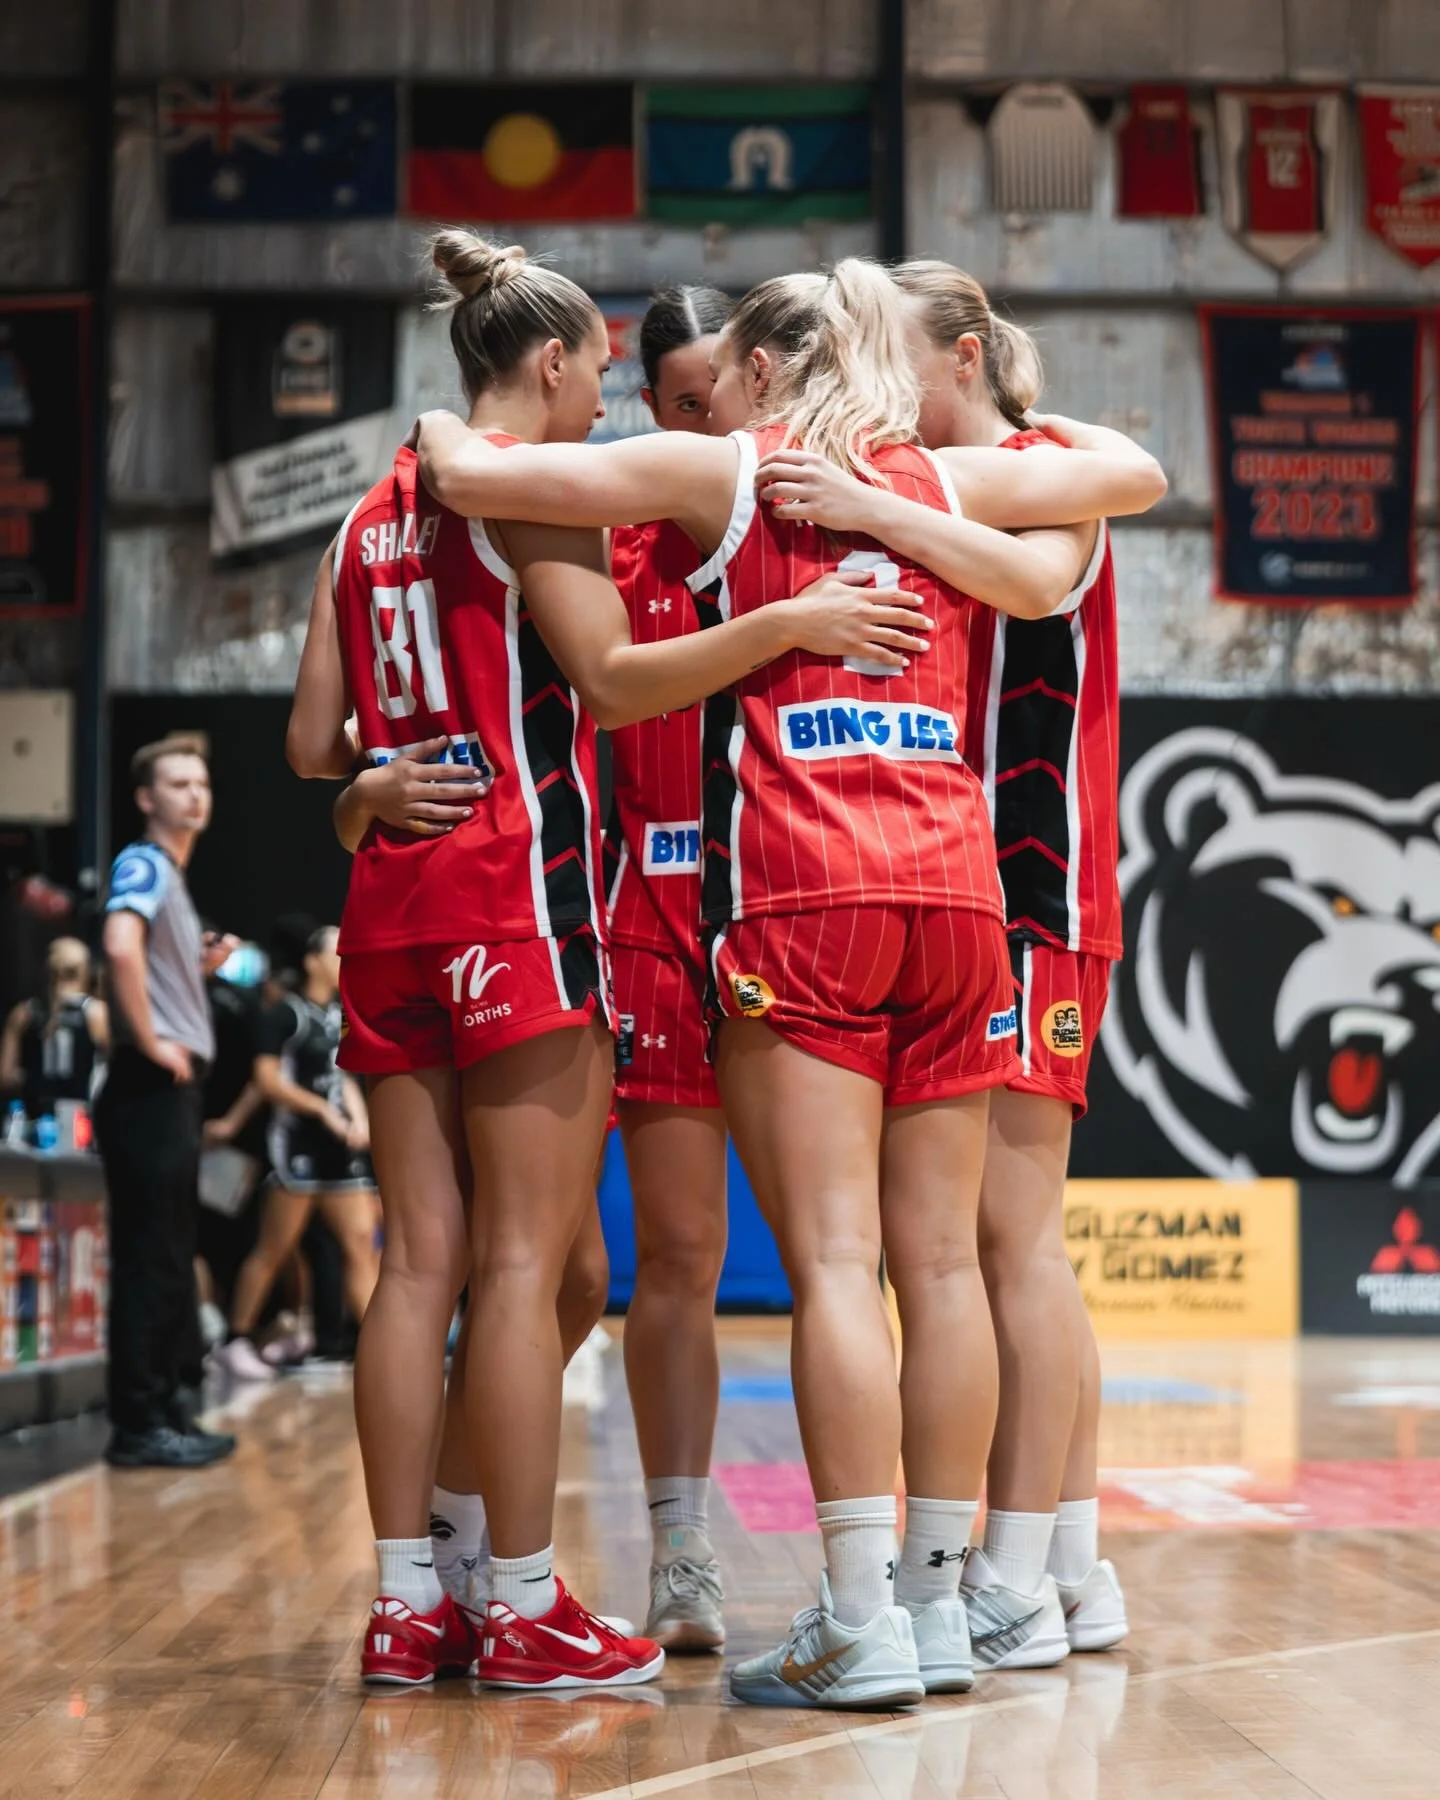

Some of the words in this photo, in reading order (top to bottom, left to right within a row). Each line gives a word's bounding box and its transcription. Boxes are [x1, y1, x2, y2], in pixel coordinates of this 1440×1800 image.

[1252, 487, 1378, 540] 2023
[369, 577, 449, 720] 81
[787, 706, 890, 750] BING
[897, 711, 955, 752] LEE
[463, 1002, 513, 1028] ORTHS
[1065, 1207, 1242, 1240] GUZMAN
